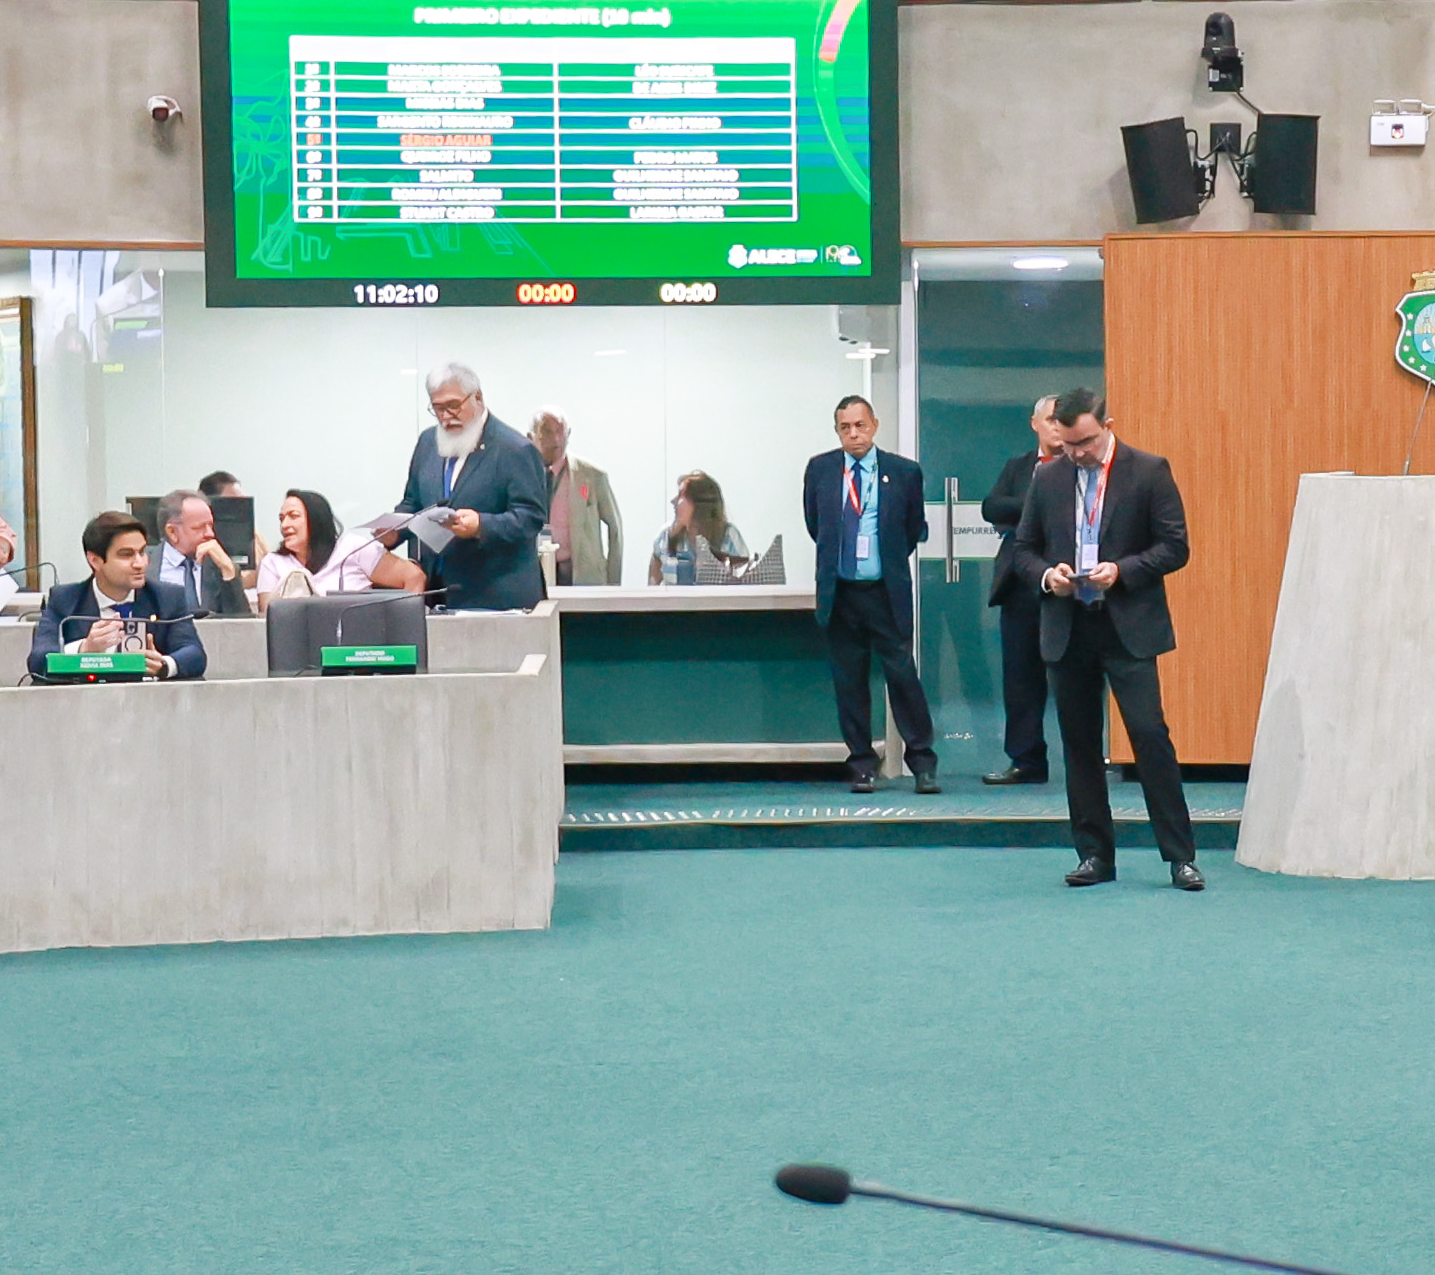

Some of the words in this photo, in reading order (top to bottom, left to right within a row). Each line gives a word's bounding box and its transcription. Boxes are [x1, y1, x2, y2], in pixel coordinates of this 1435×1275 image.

[445, 134, 493, 146] AGUIAR
[354, 284, 439, 304] 11:02:10
[517, 284, 576, 303] 00:00
[660, 283, 717, 303] 00:00
